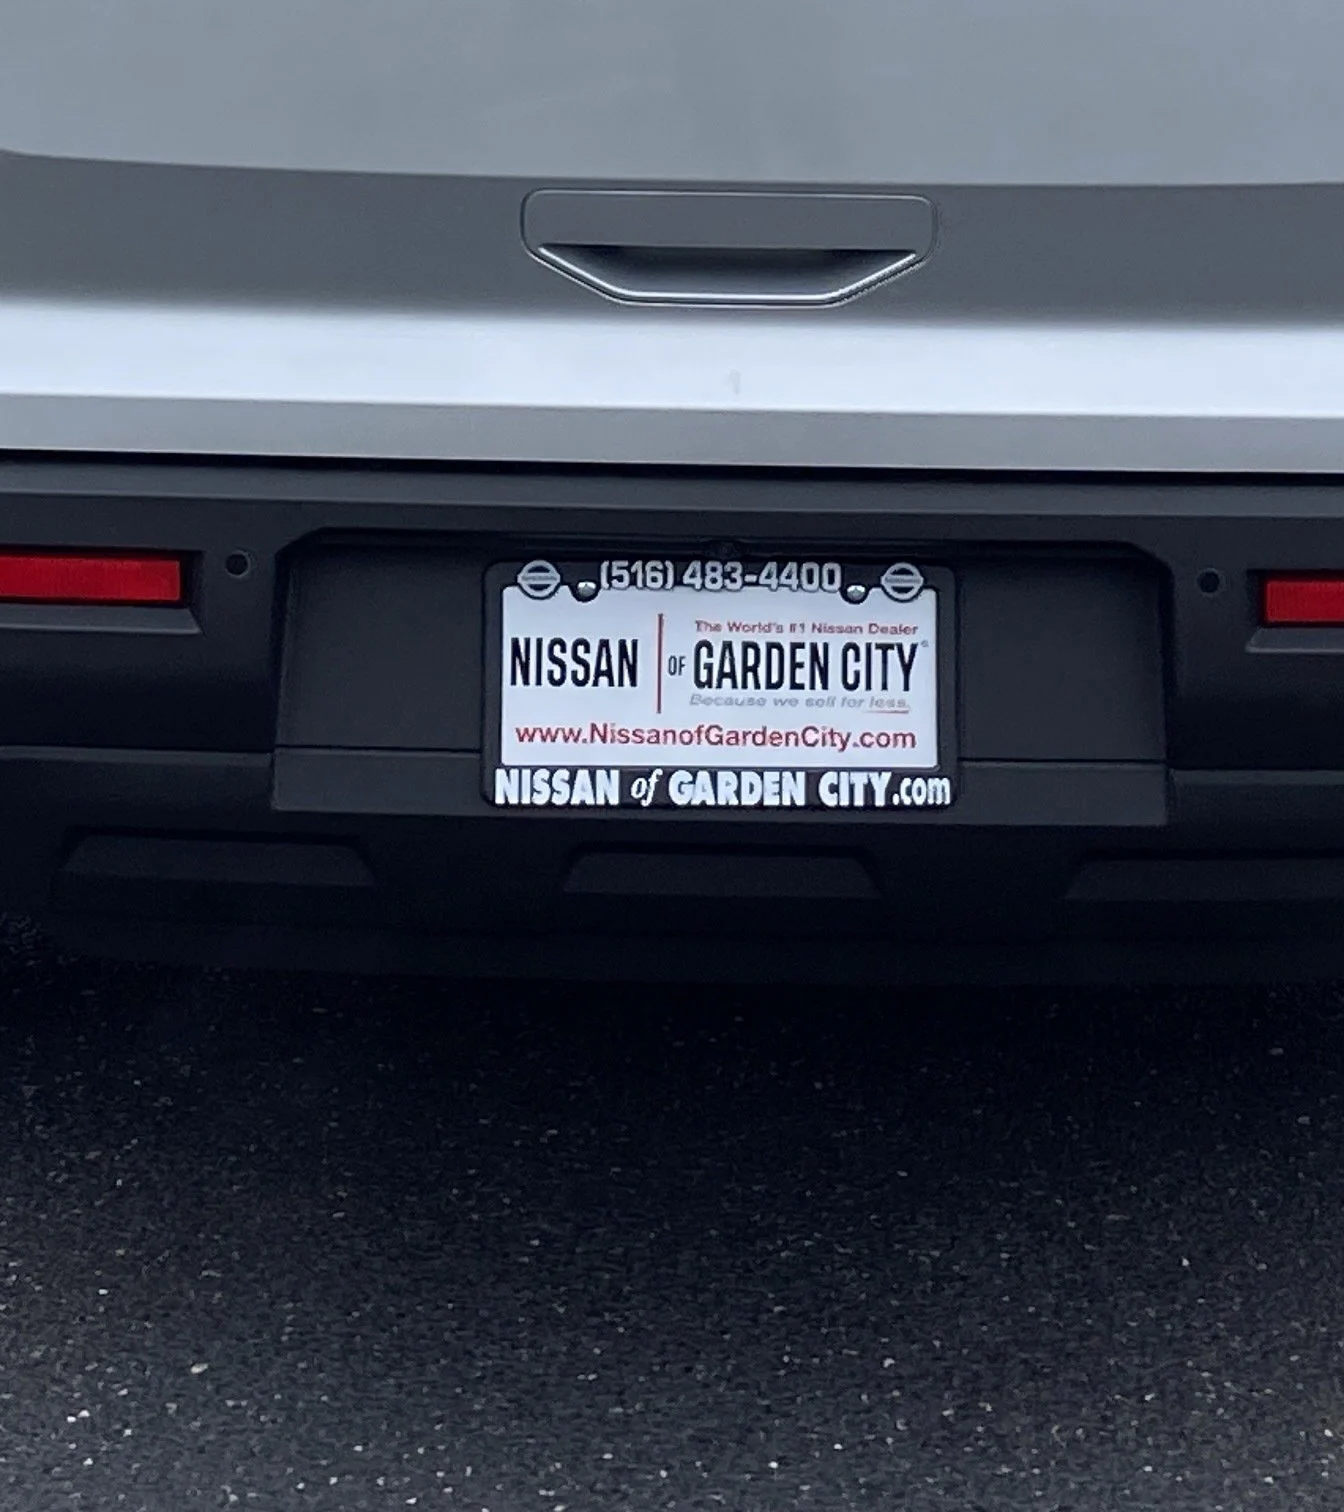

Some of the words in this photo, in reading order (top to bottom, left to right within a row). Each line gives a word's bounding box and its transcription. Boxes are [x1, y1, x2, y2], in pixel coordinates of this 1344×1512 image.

[600, 559, 674, 591] (516)
[682, 560, 843, 593] 483-4400
[695, 620, 722, 633] The
[727, 620, 784, 634] World's
[811, 622, 864, 635] Nissan
[867, 622, 919, 636] Dealer
[510, 637, 639, 687] NISSAN
[668, 655, 686, 676] OF
[693, 638, 829, 691] GARDEN
[841, 641, 919, 692] CITY
[689, 694, 767, 707] Because
[773, 696, 799, 707] we
[840, 695, 865, 708] for
[515, 722, 916, 752] www.NissanofGardenCity.com
[494, 767, 620, 806] NISSAN
[630, 768, 664, 807] of
[668, 769, 806, 806] GARDEN
[818, 770, 951, 807] CITY.com
